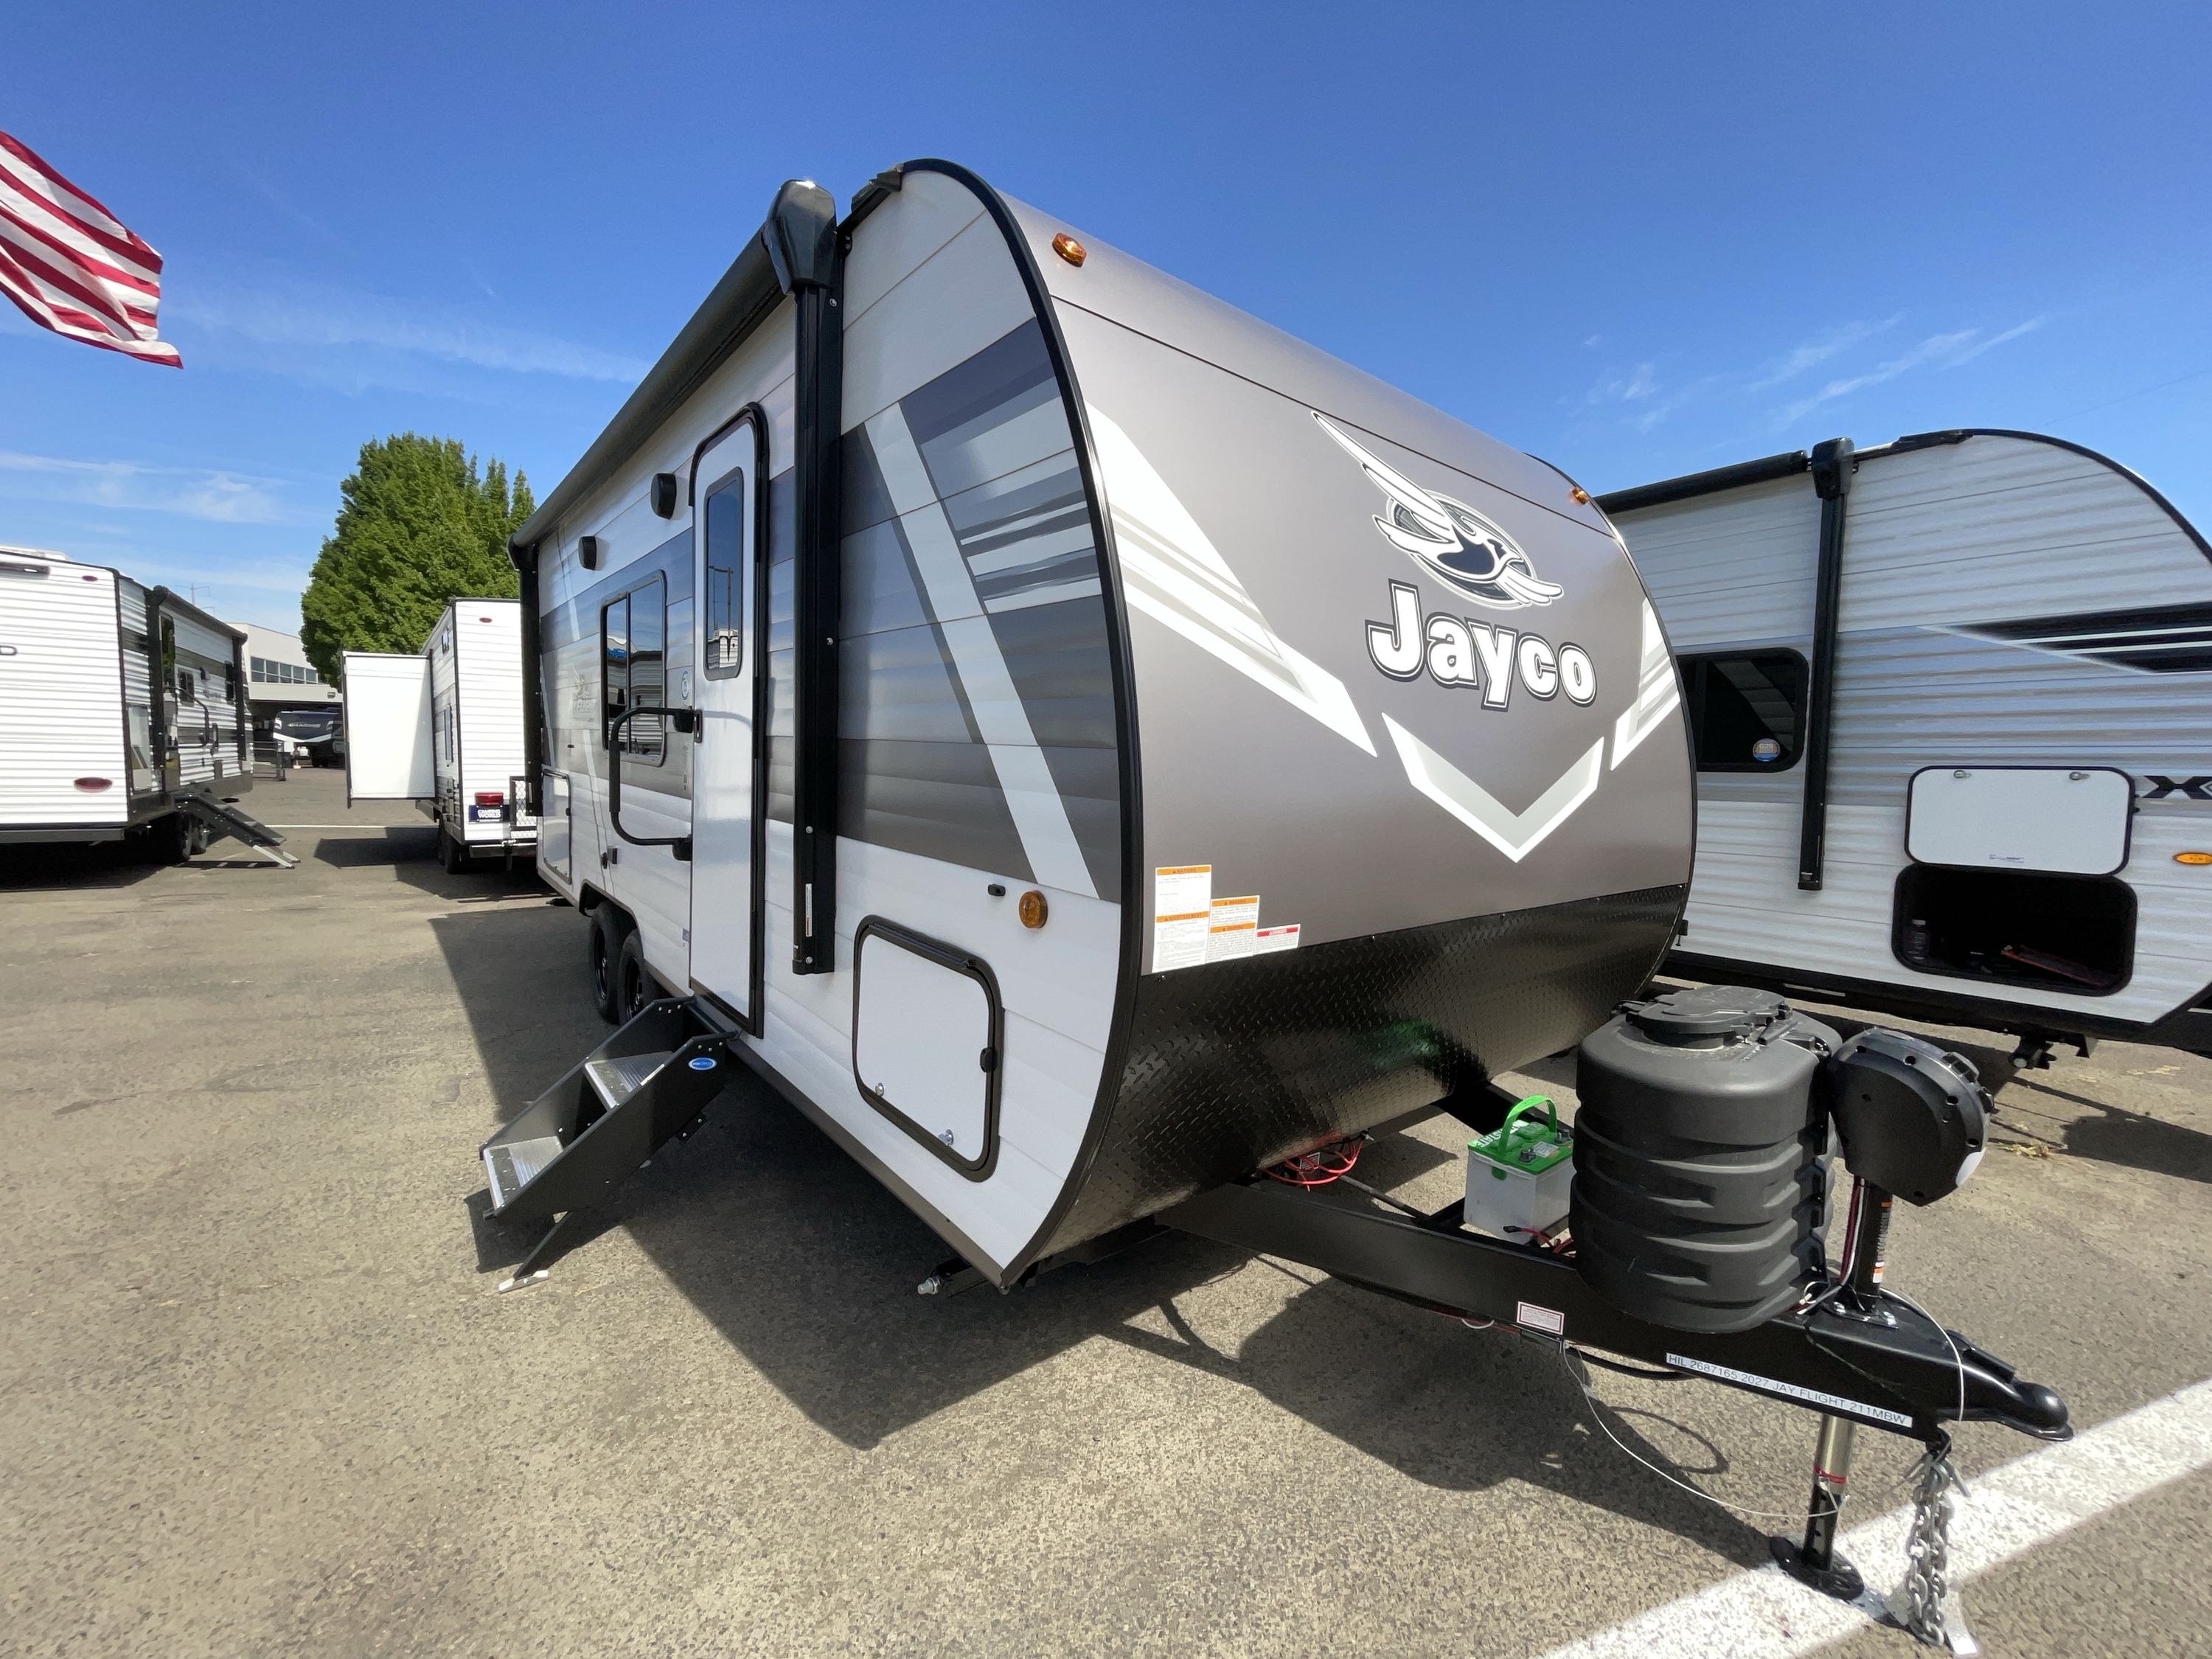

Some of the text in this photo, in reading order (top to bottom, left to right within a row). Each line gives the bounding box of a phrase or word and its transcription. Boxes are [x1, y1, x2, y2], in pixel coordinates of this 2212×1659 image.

[1365, 578, 1597, 712] Jayco
[1669, 1354, 1907, 1425] HIL 2687165 2027 JAY FLIGHT 211MBW
